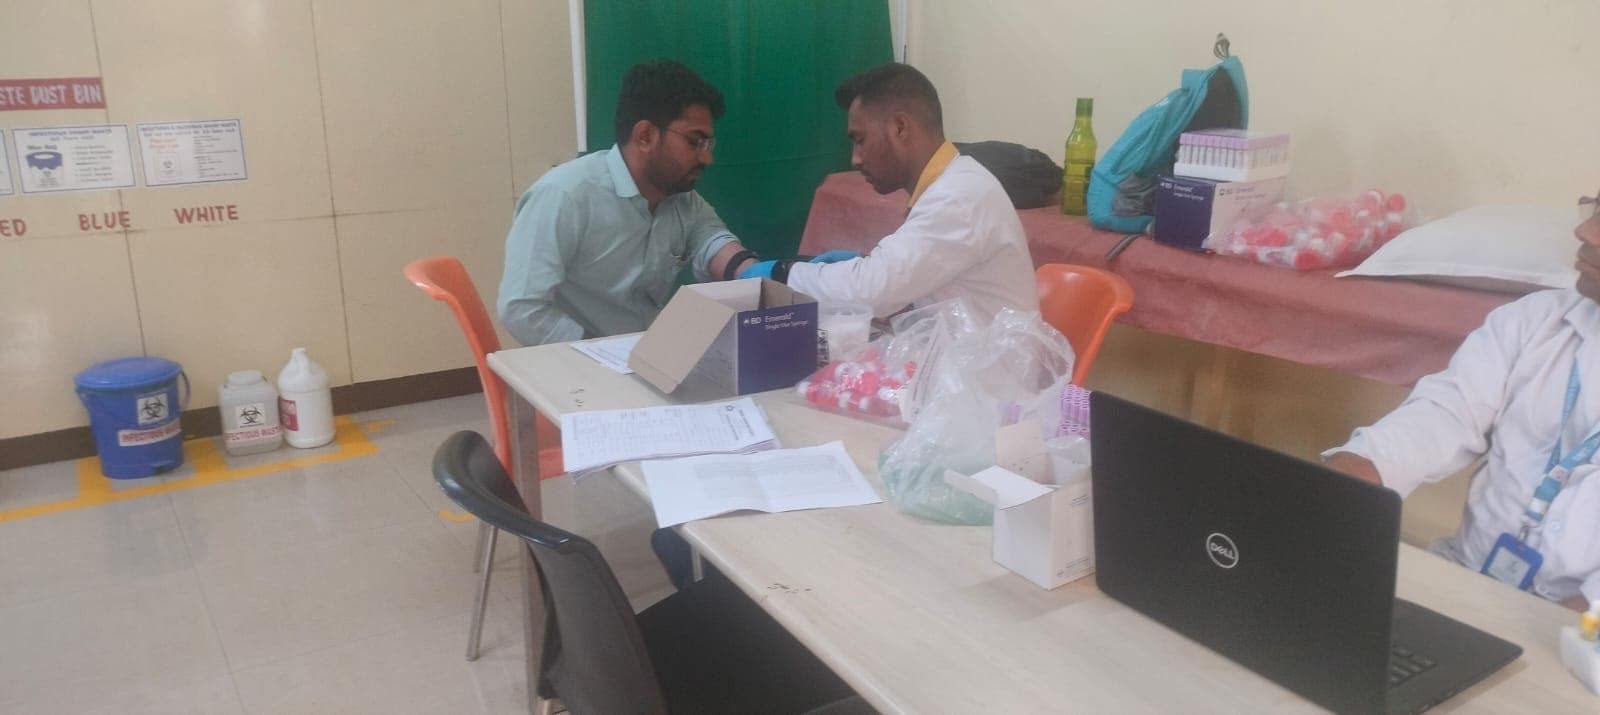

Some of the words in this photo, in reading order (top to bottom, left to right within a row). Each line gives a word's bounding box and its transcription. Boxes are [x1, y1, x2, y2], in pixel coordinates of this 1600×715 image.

[31, 85, 66, 104] DUST
[73, 83, 102, 104] BIN
[78, 210, 131, 231] BLUE
[174, 204, 239, 225] WHITE
[0, 218, 26, 237] ED
[751, 316, 762, 325] BD
[1210, 542, 1234, 559] DELL
